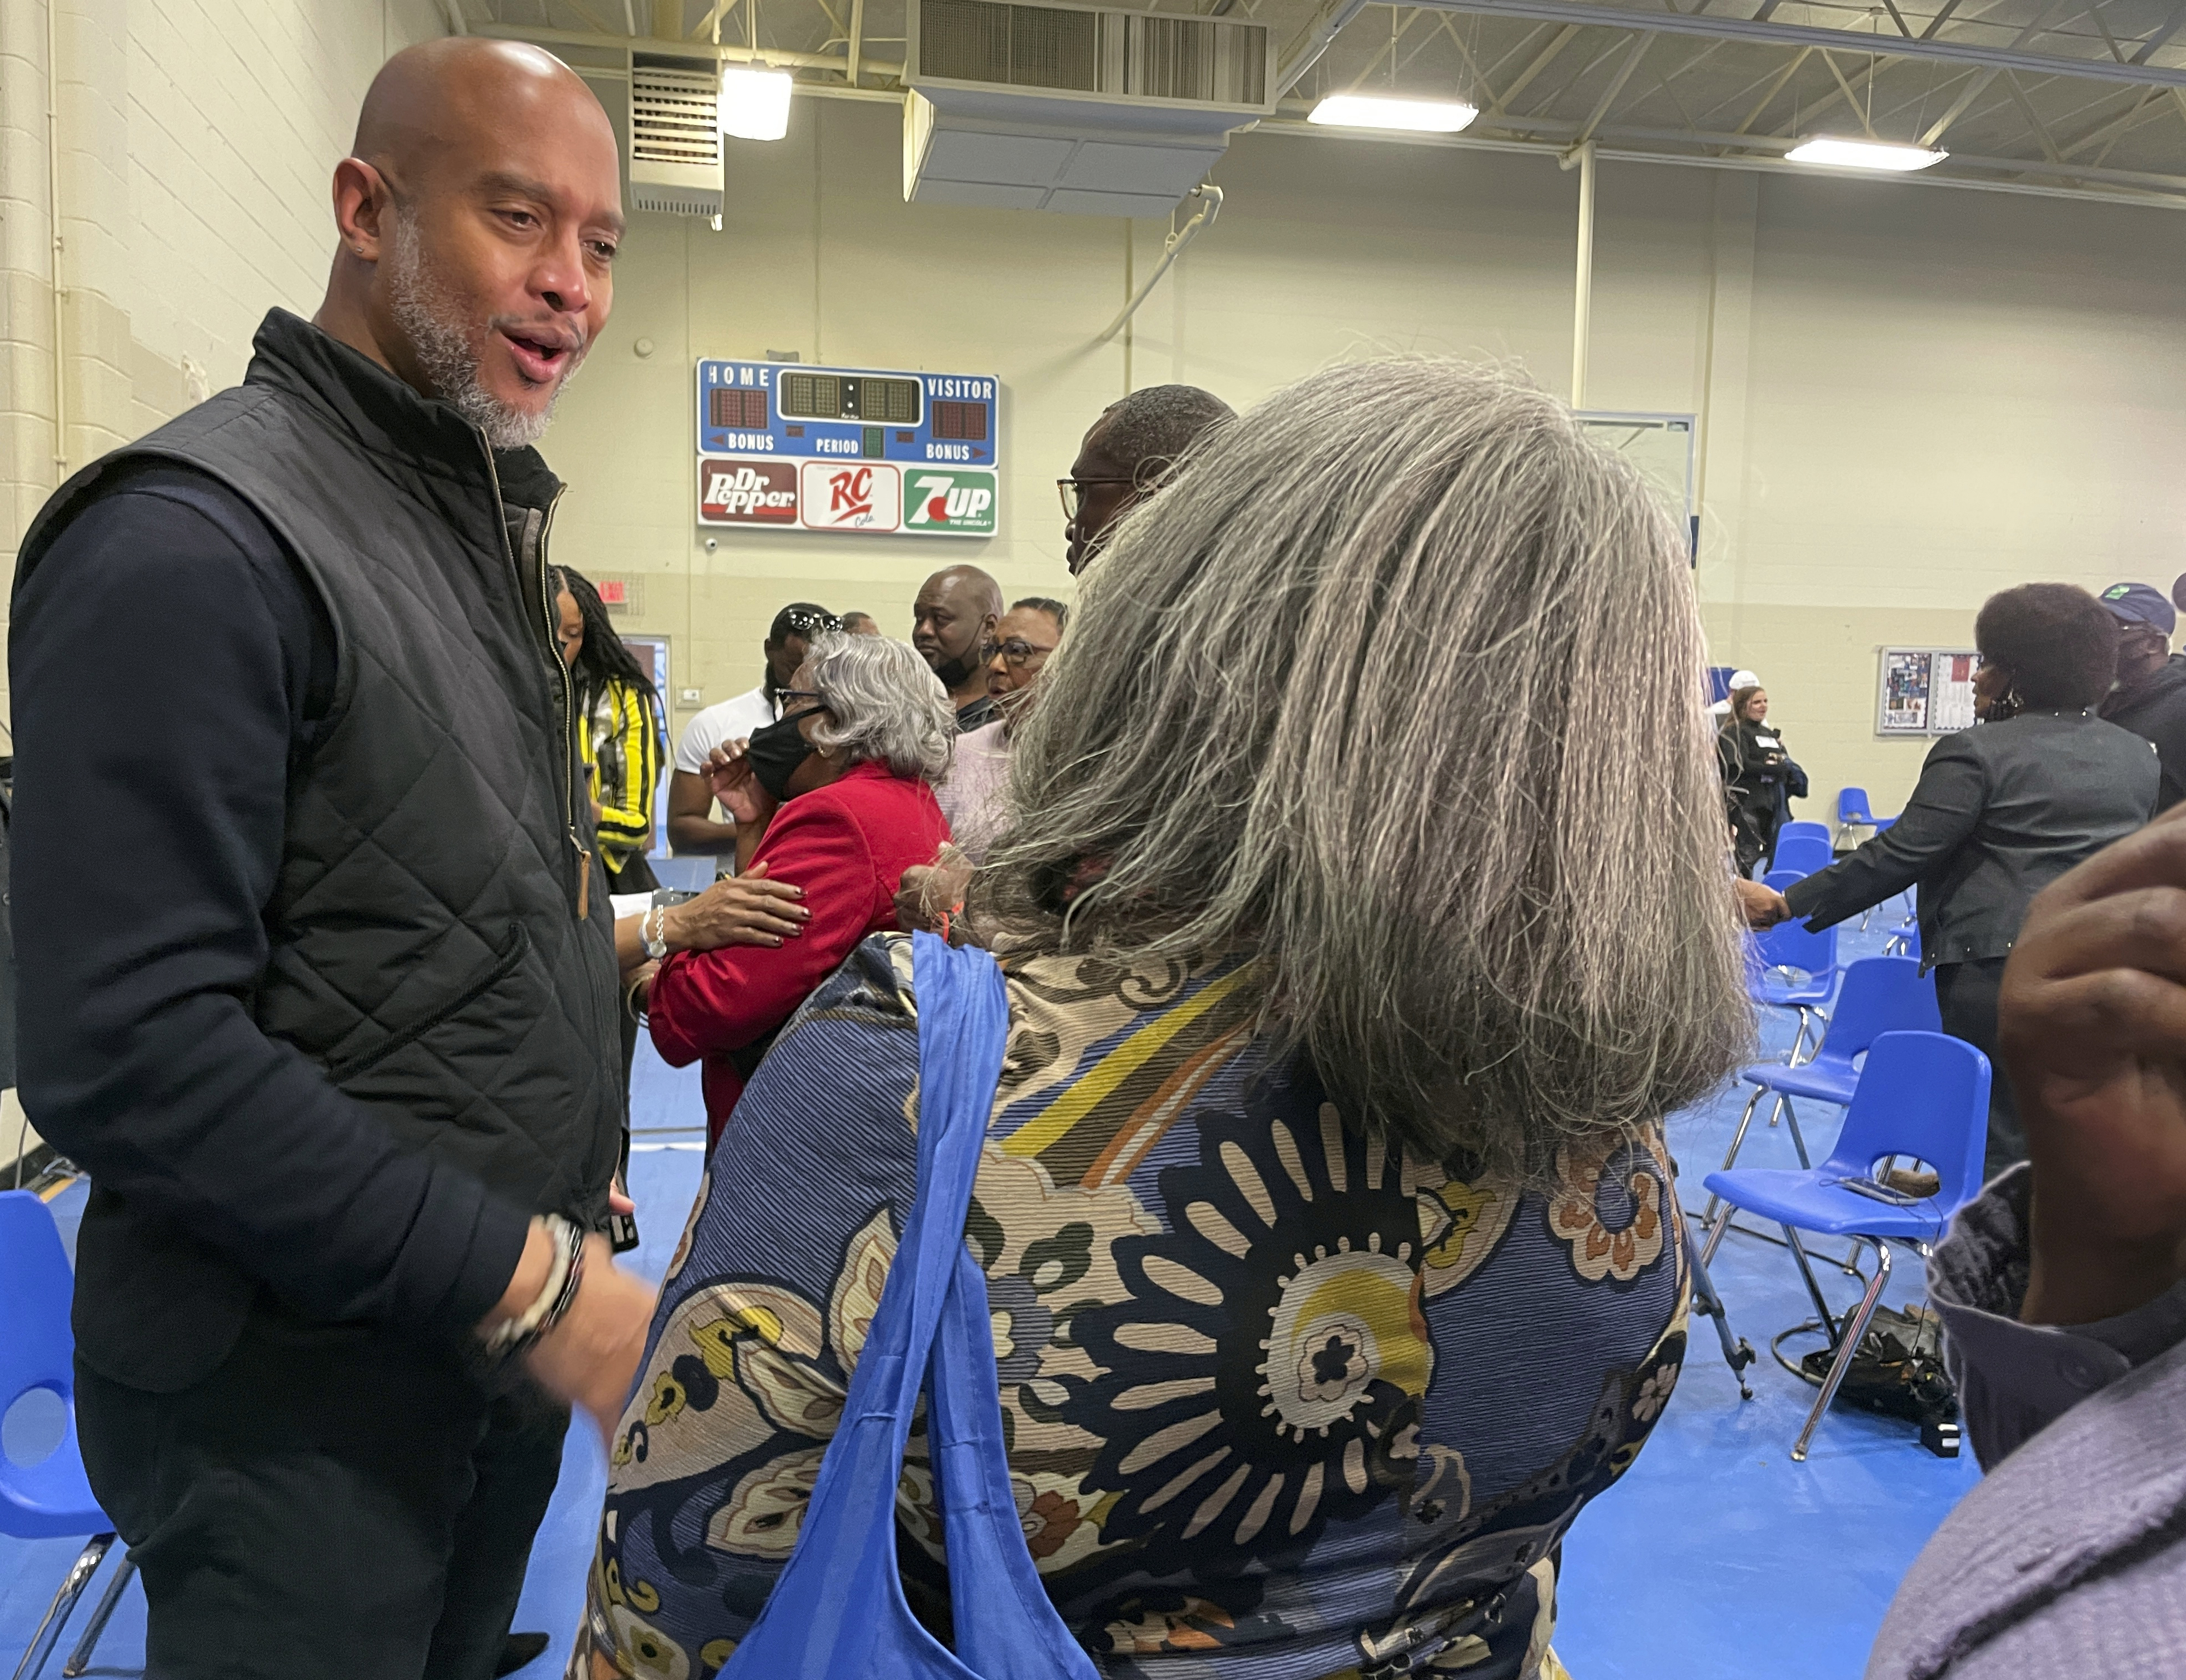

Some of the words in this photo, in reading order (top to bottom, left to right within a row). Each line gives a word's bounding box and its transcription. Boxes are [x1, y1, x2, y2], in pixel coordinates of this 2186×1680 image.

[708, 365, 769, 386] HOME
[927, 378, 992, 399] VISITOR
[728, 432, 774, 451] BONUS
[816, 438, 858, 454] PERIOD
[926, 443, 969, 461] BONUS
[733, 468, 770, 491] Dr
[829, 468, 873, 512] RC
[703, 473, 796, 514] Pepper
[856, 514, 874, 528] Cola
